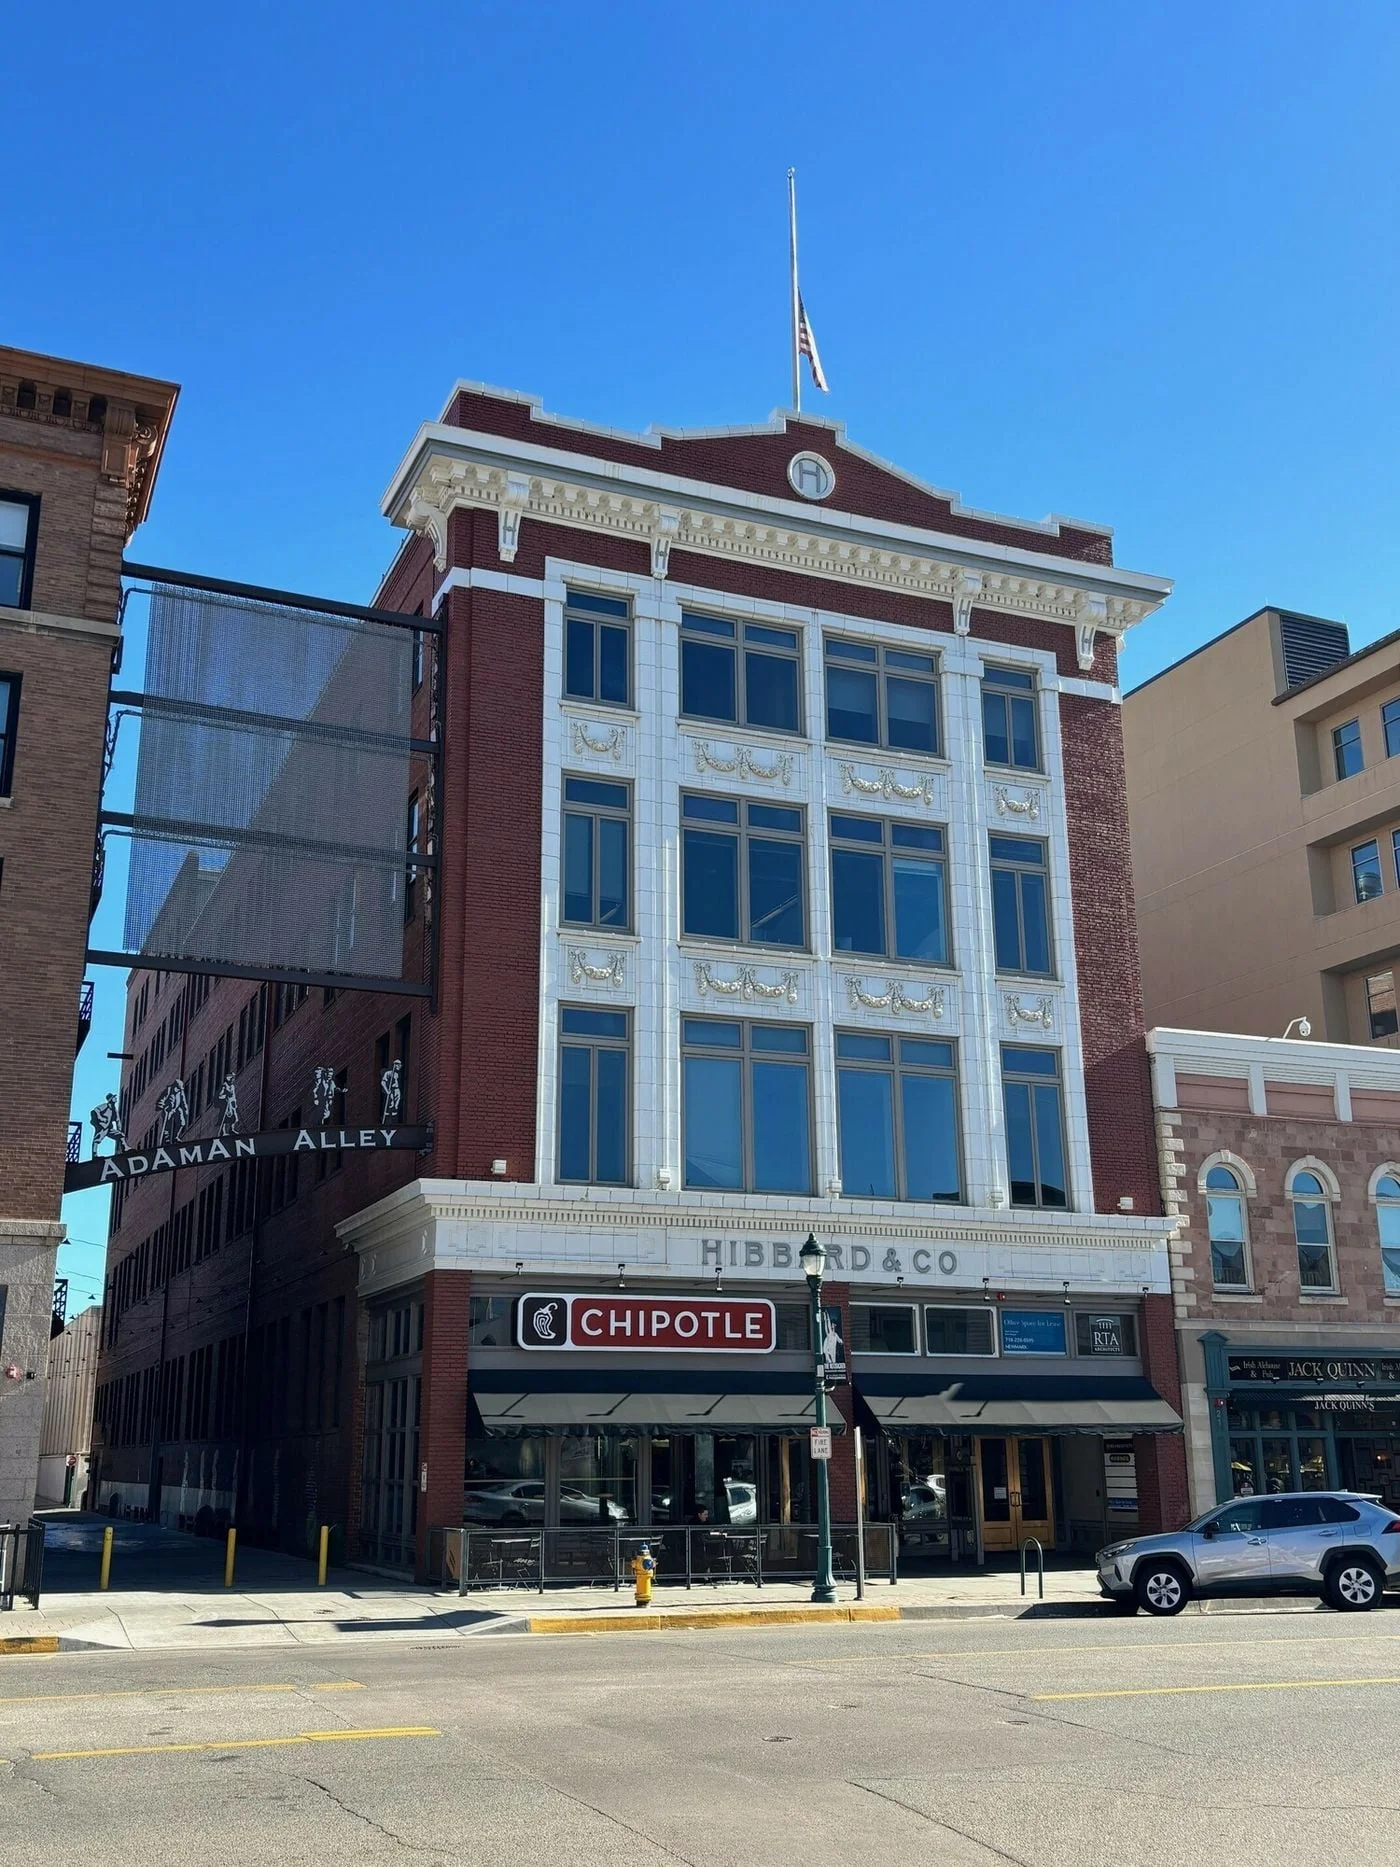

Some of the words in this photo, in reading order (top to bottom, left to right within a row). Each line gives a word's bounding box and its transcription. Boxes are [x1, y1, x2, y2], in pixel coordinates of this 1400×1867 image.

[799, 462, 820, 493] H
[100, 1138, 256, 1181] ADAMAN
[293, 1129, 398, 1151] ALLEY
[701, 1239, 871, 1271] HIBBRD
[882, 1247, 901, 1271] &
[913, 1249, 957, 1275] CO
[580, 1308, 764, 1339] CHIPOTLE
[1093, 1331, 1119, 1346] RTA
[1250, 1370, 1257, 1378] &
[1288, 1362, 1324, 1377] JACK
[1327, 1362, 1376, 1380] QUINN
[1314, 1401, 1338, 1410] JACK
[1339, 1401, 1375, 1411] QUINN'S
